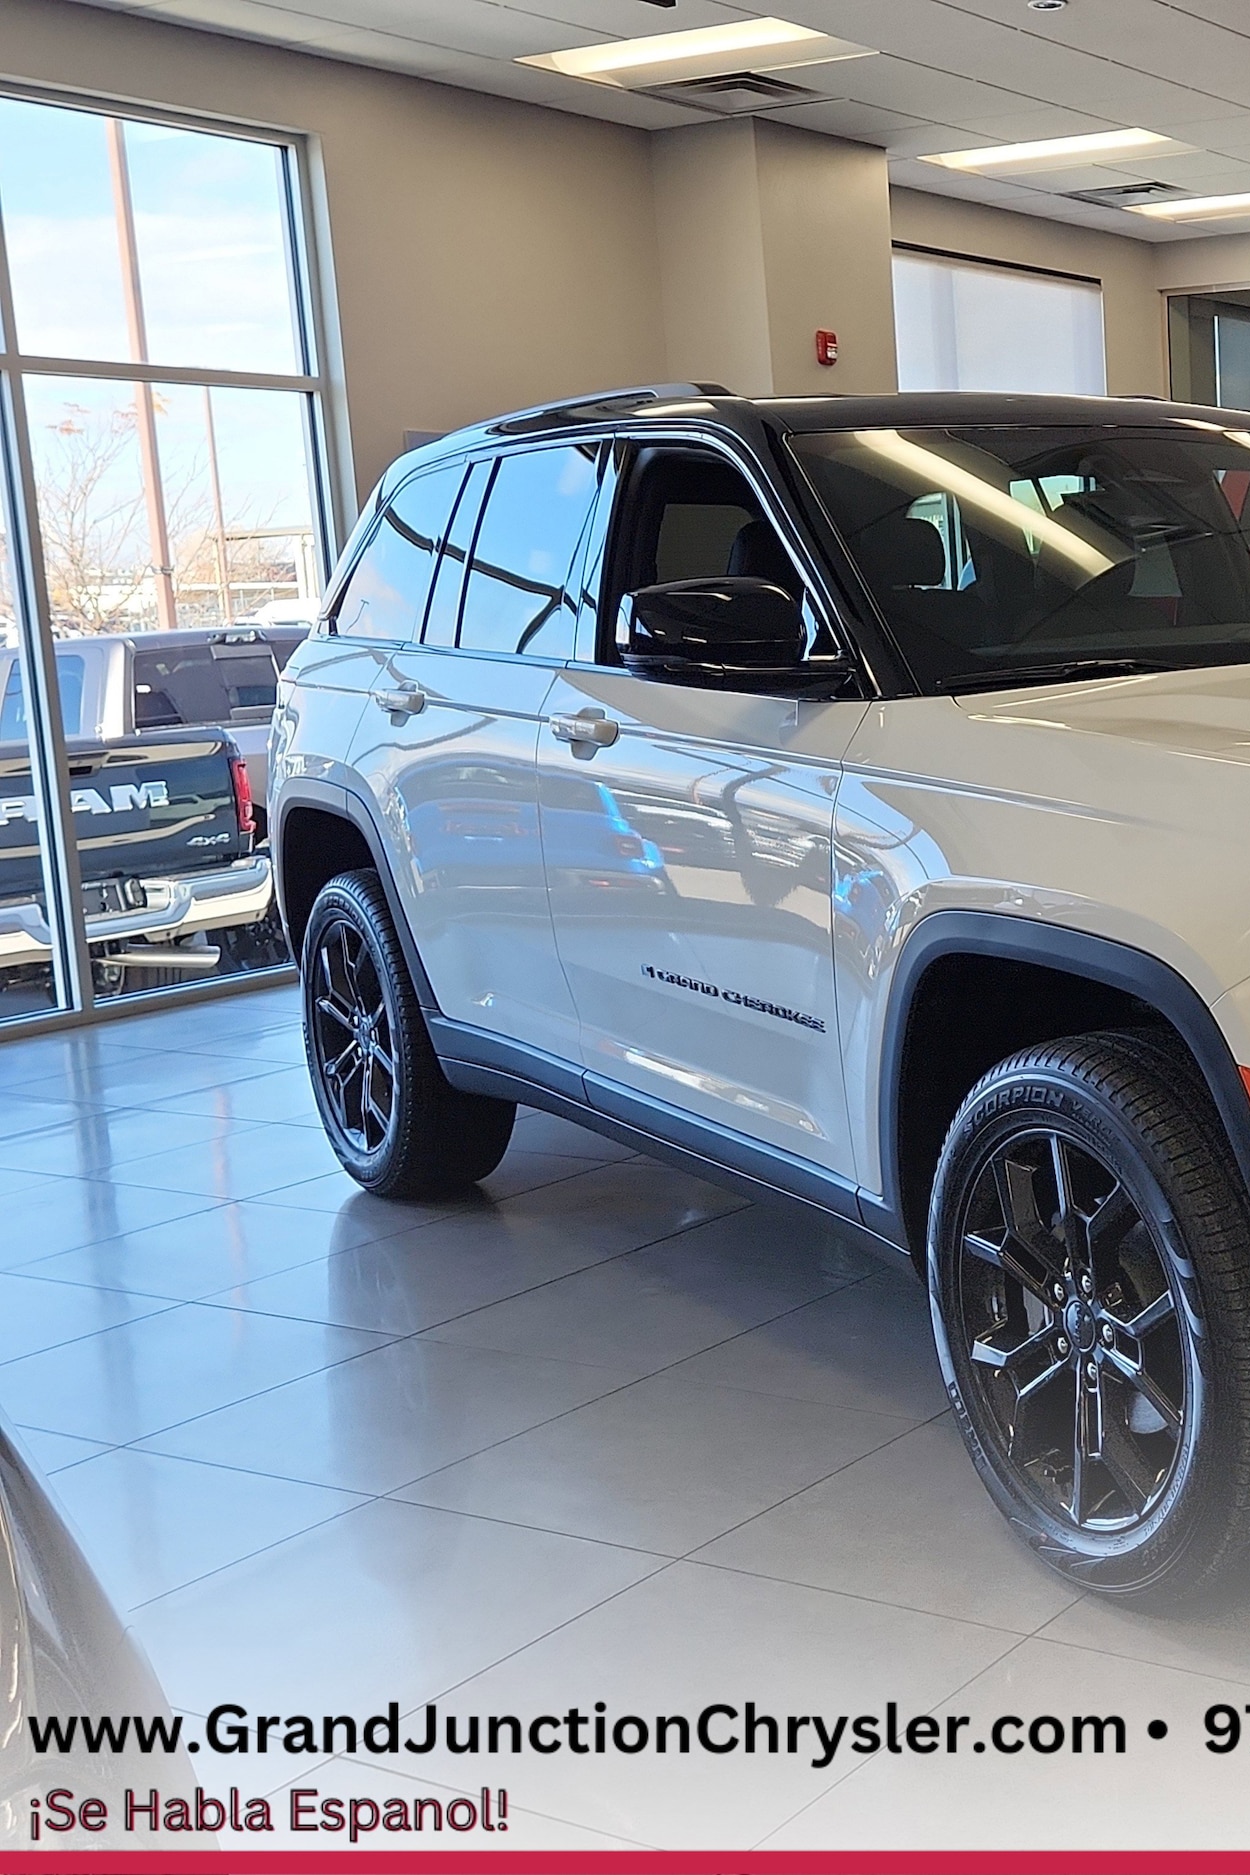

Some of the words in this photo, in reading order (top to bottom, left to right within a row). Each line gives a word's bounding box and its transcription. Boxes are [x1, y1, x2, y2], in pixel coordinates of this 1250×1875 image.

[656, 969, 719, 998] GRAND
[721, 988, 827, 1034] CHEROKEE
[962, 1085, 1065, 1140] SCORPION
